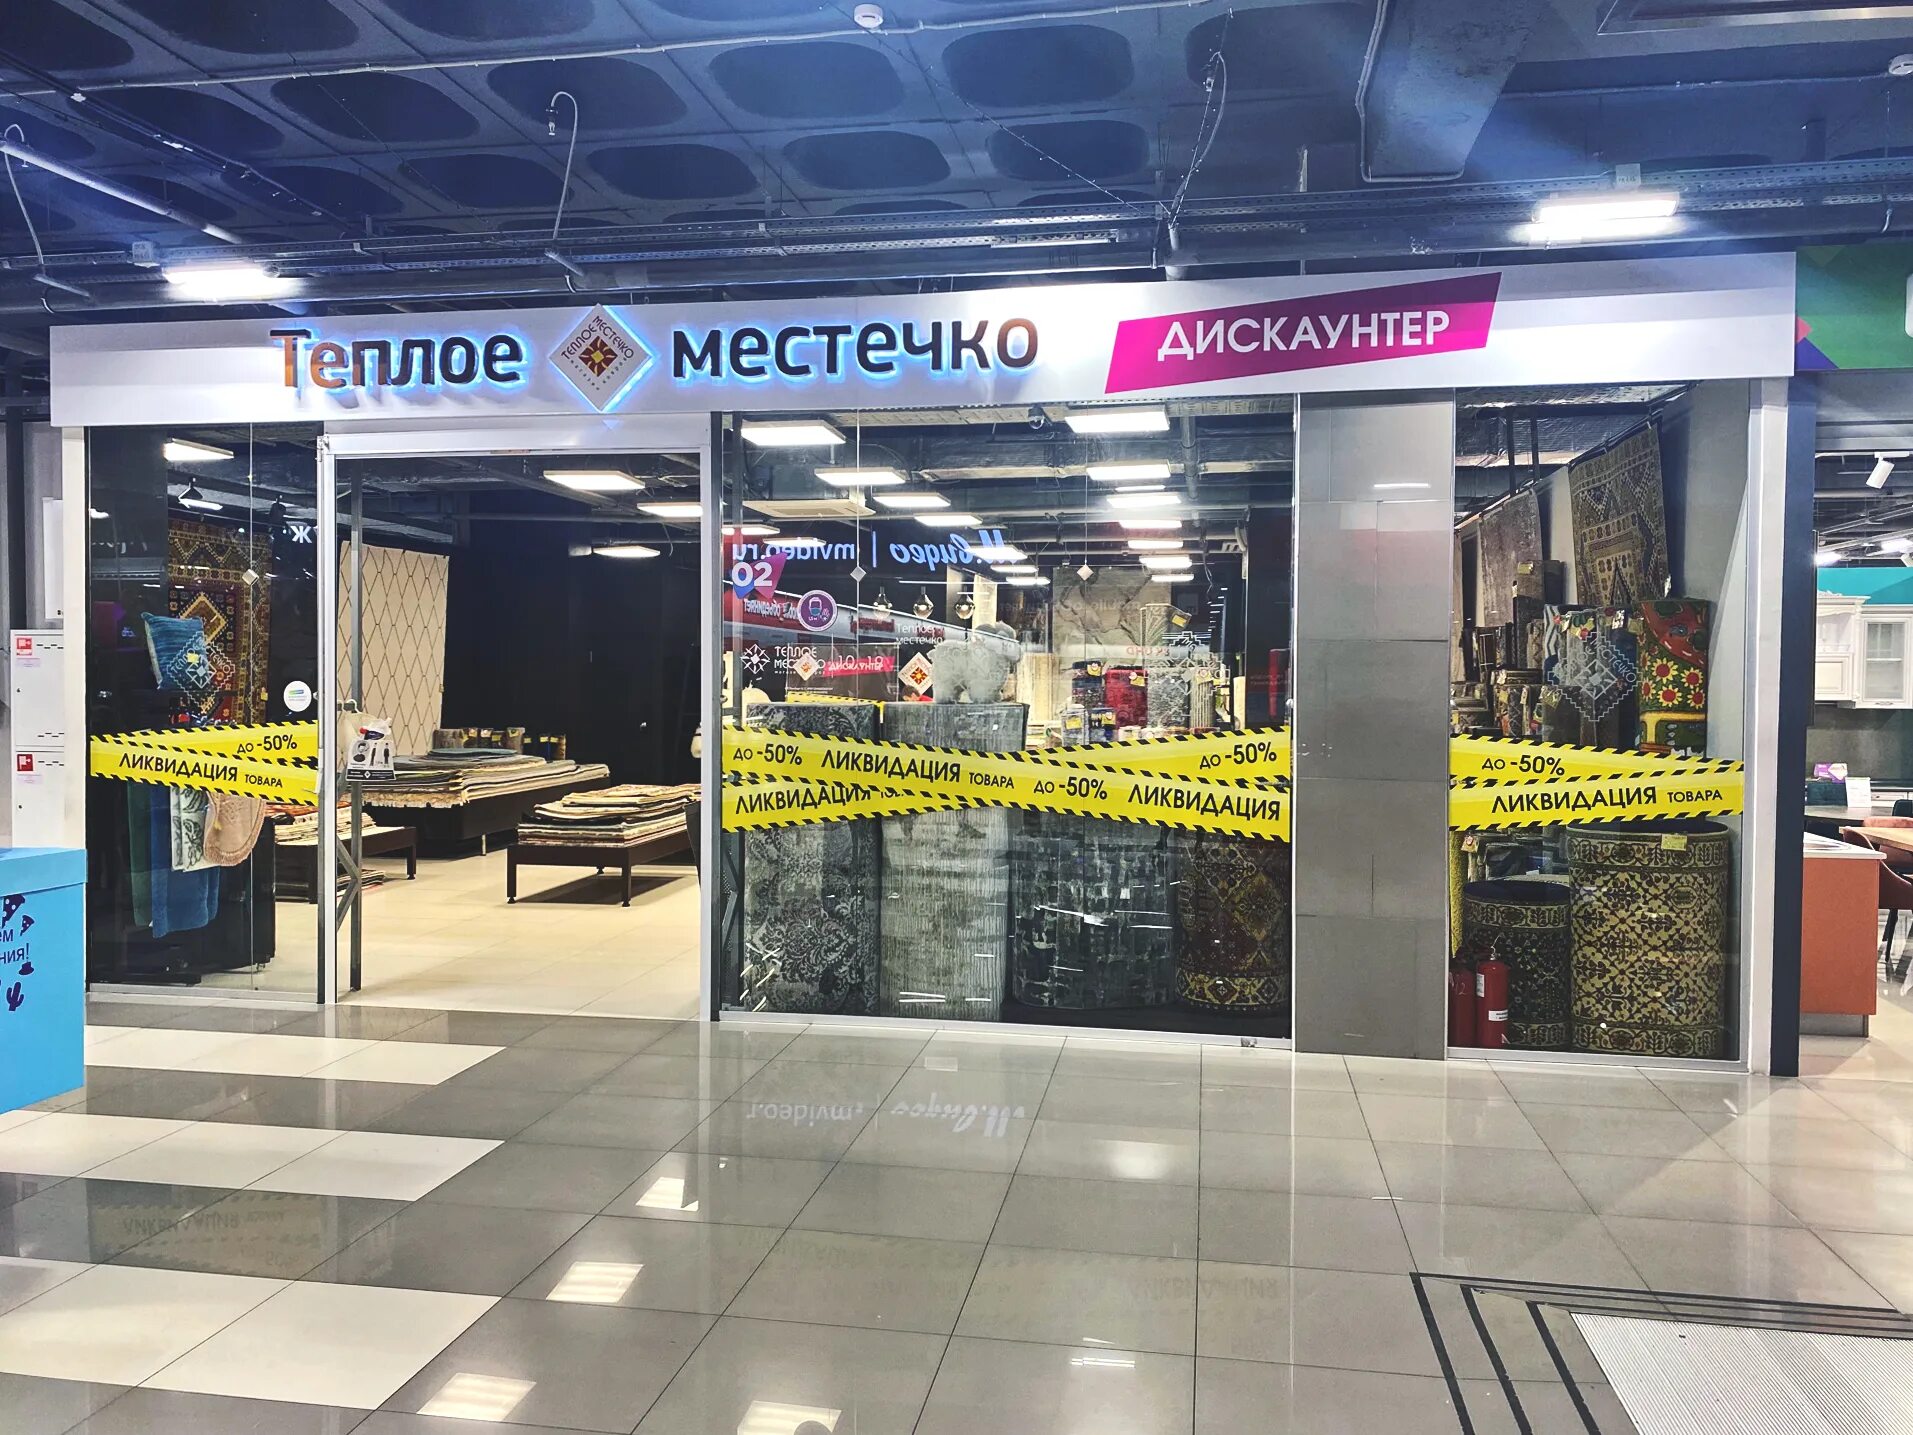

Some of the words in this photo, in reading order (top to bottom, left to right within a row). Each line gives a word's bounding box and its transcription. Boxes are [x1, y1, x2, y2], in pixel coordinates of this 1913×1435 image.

[561, 324, 597, 359] ТЕПЛОЕ
[592, 315, 634, 359] МЕСТЕЧКО
[1157, 310, 1450, 362] ДИСКАУНТЕР
[269, 328, 524, 389] Теплое
[672, 317, 1039, 378] местечко
[732, 561, 773, 587] 02
[256, 734, 298, 752] -50%
[1224, 741, 1277, 765] -50%
[119, 753, 238, 781] ЛИКВИДАЦИЯ
[244, 774, 283, 788] ТОВАРА
[1510, 754, 1565, 776] -50%
[757, 743, 802, 766] -50%
[821, 749, 961, 783] ЛИКВИДАЦИЯ
[969, 772, 1015, 789] ТОВАРА
[1058, 776, 1108, 800] -50%
[1127, 784, 1281, 821] ЛИКВИДАЦИЯ
[1491, 786, 1657, 814] ЛИКВИДАЦИЯ
[1667, 789, 1723, 803] ТОВАРА
